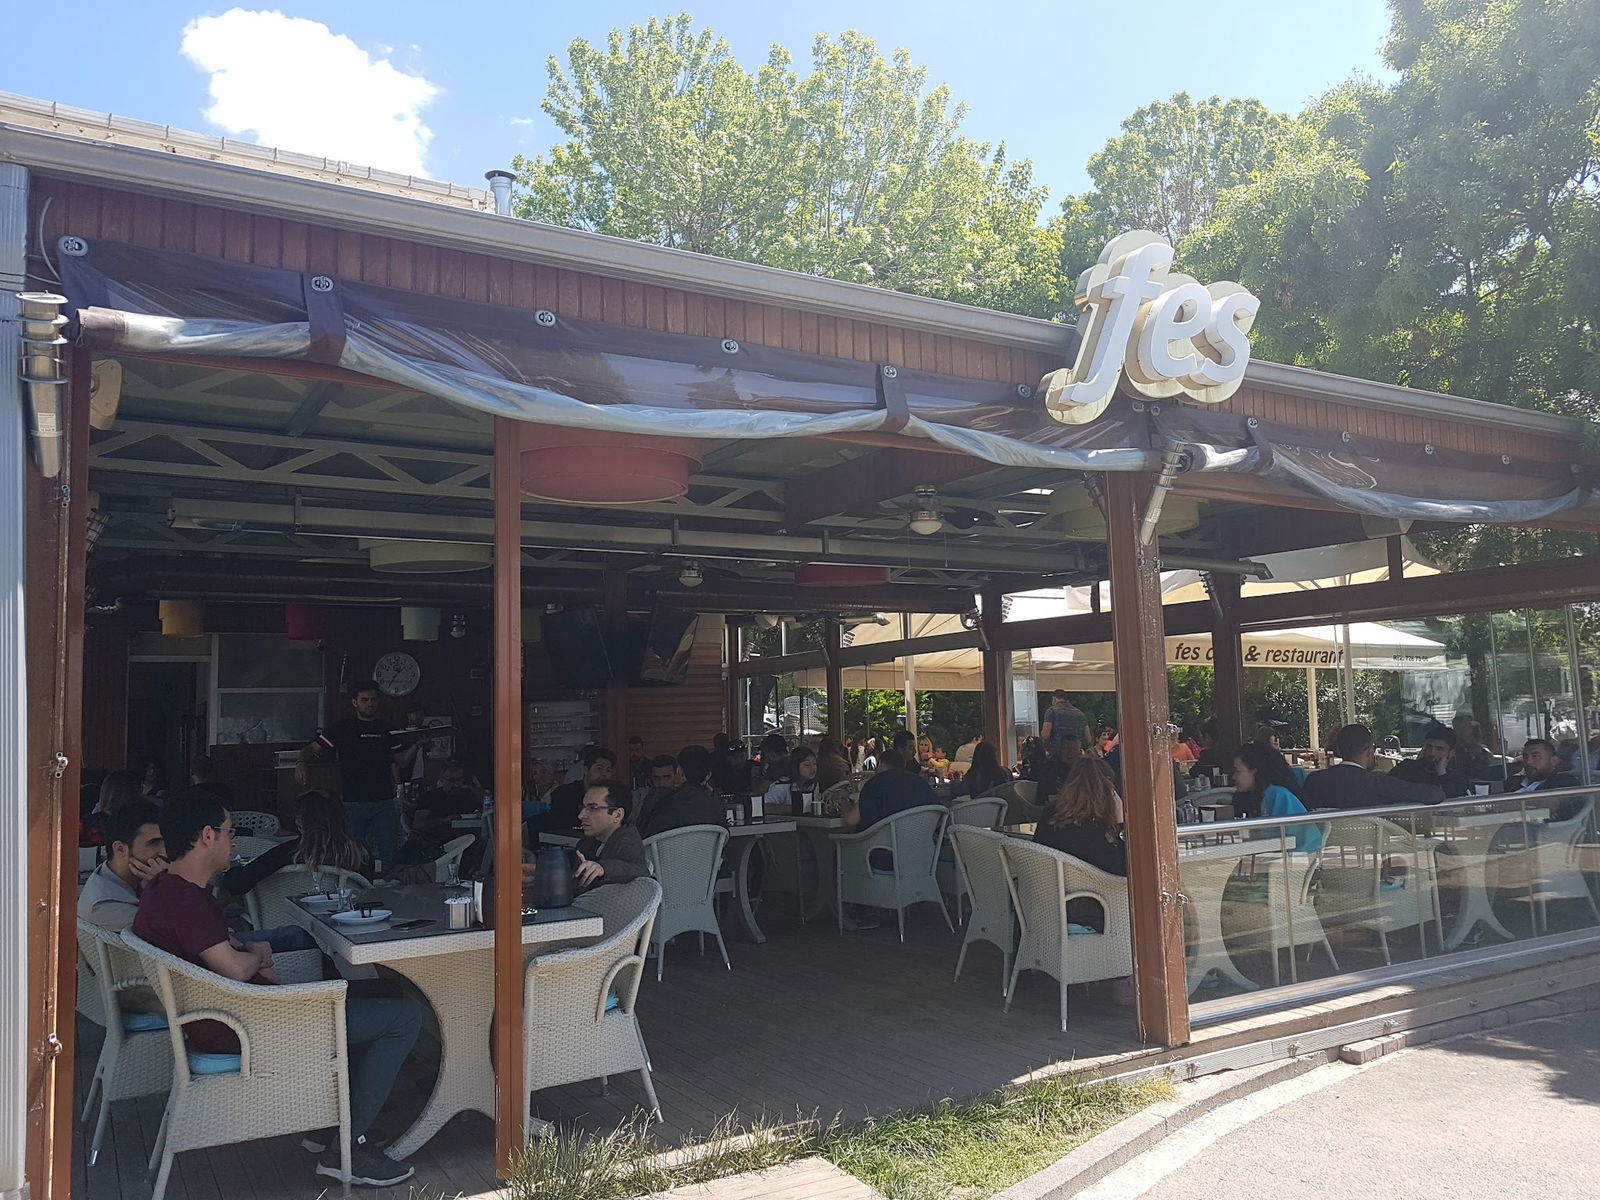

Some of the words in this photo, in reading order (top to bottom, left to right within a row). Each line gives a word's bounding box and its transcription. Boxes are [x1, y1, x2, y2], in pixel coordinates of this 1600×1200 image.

[1058, 241, 1261, 405] fes
[1175, 643, 1201, 660] fes
[1244, 645, 1261, 662] &
[1264, 647, 1344, 663] restaurant
